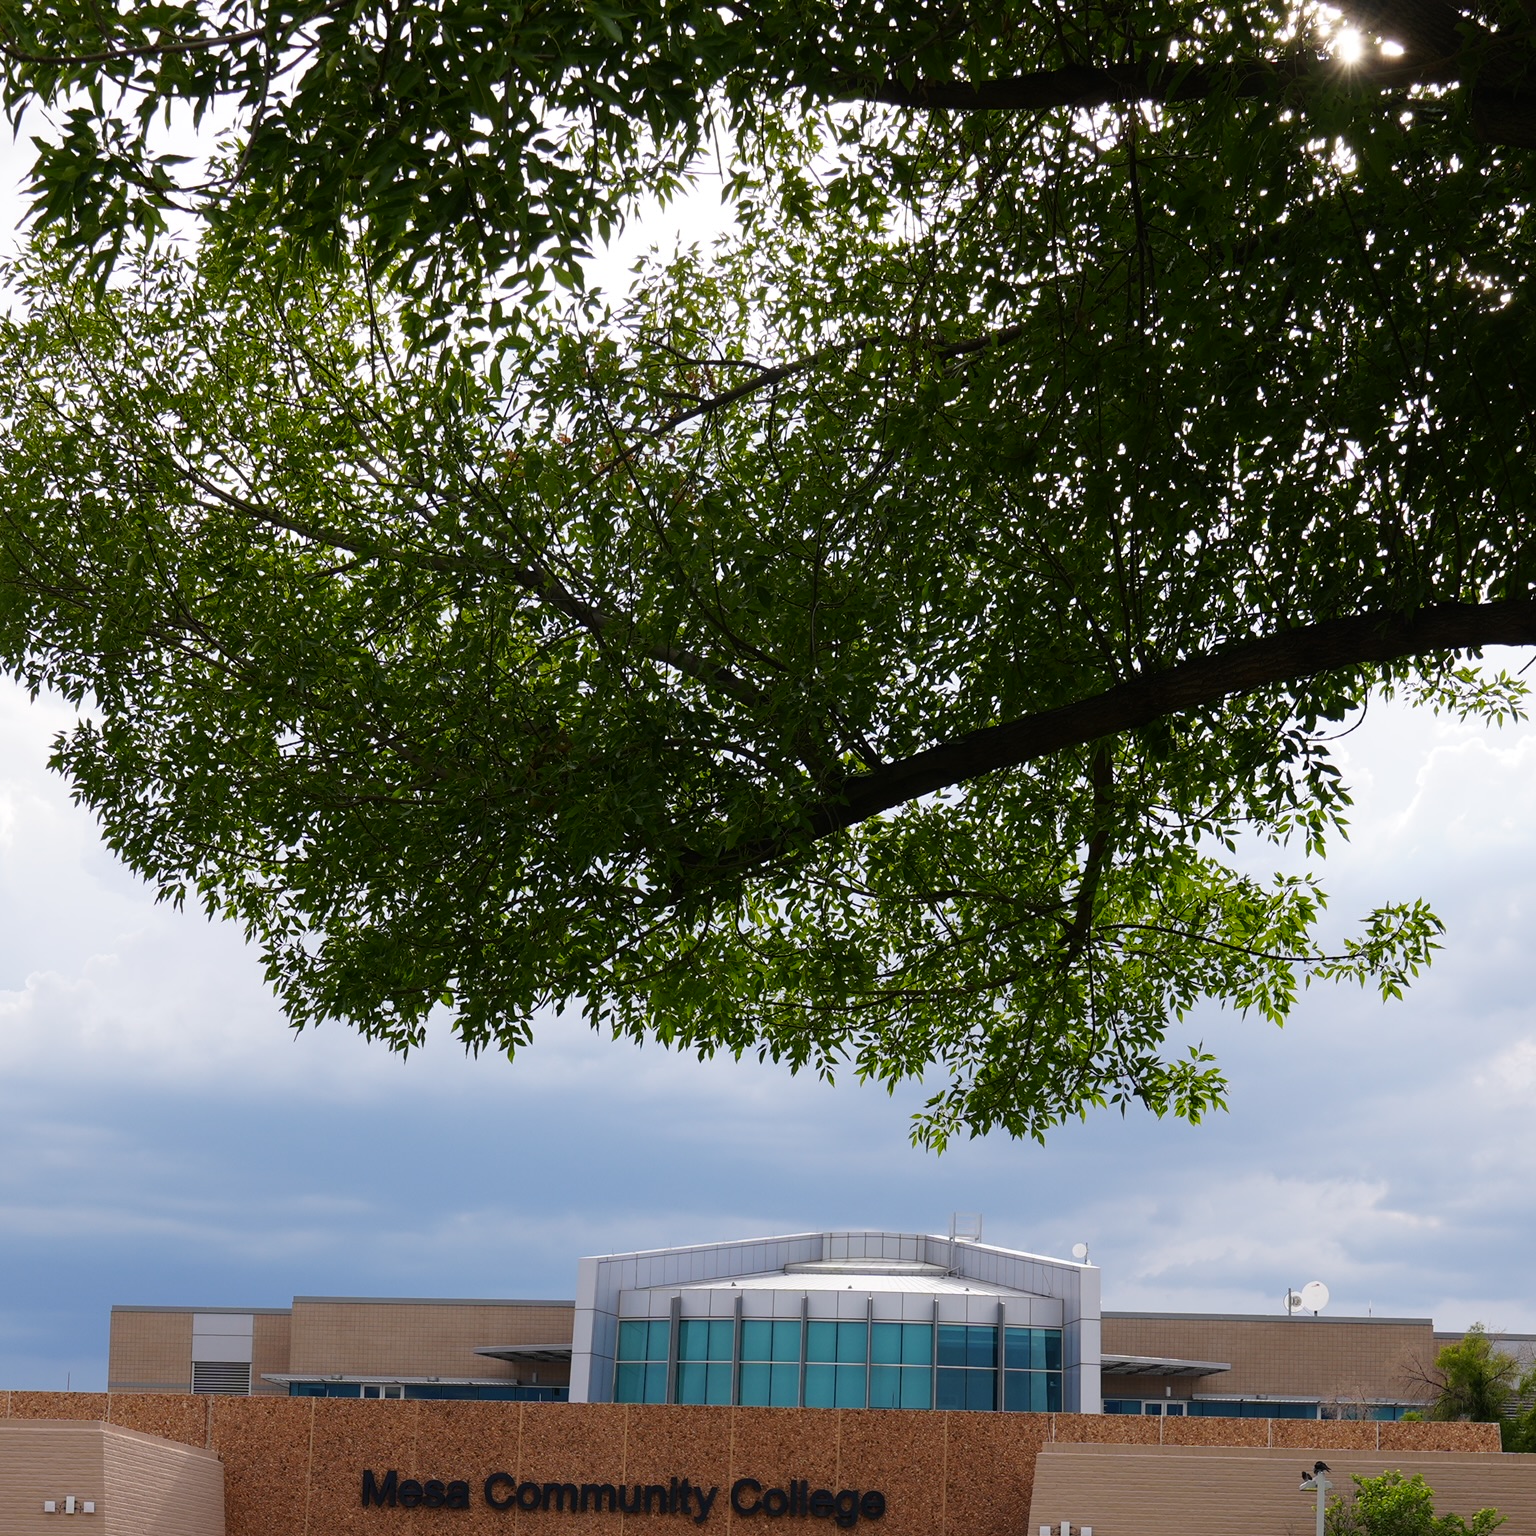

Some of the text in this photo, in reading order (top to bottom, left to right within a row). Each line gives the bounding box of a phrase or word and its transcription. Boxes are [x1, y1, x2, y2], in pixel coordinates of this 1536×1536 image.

[362, 1469, 887, 1529] Mesa Community College
